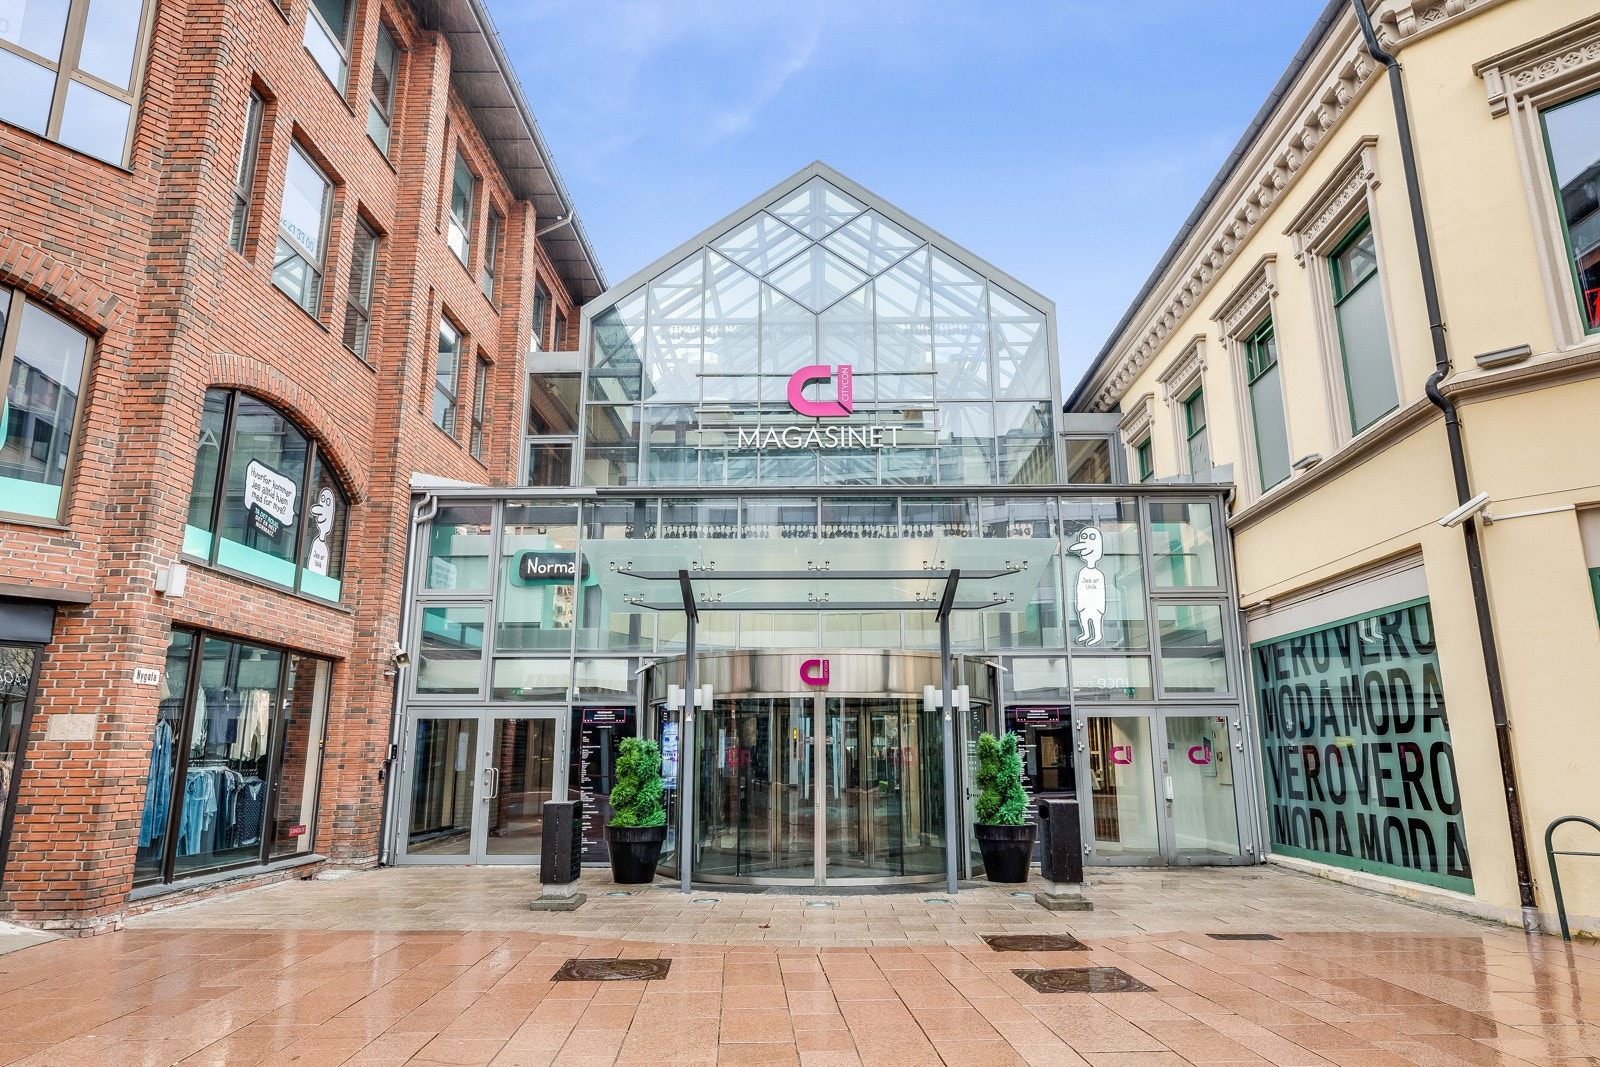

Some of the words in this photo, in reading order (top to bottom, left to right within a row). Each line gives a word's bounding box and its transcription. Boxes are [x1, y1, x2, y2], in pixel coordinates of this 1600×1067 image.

[841, 367, 849, 402] CITYCON
[737, 425, 903, 449] MAGASINET
[251, 467, 272, 486] Hvorfor
[272, 479, 292, 498] kommer
[252, 491, 262, 504] med
[263, 496, 272, 507] for
[272, 502, 287, 515] mye?
[527, 556, 576, 574] Norma
[136, 669, 157, 684] Nygata
